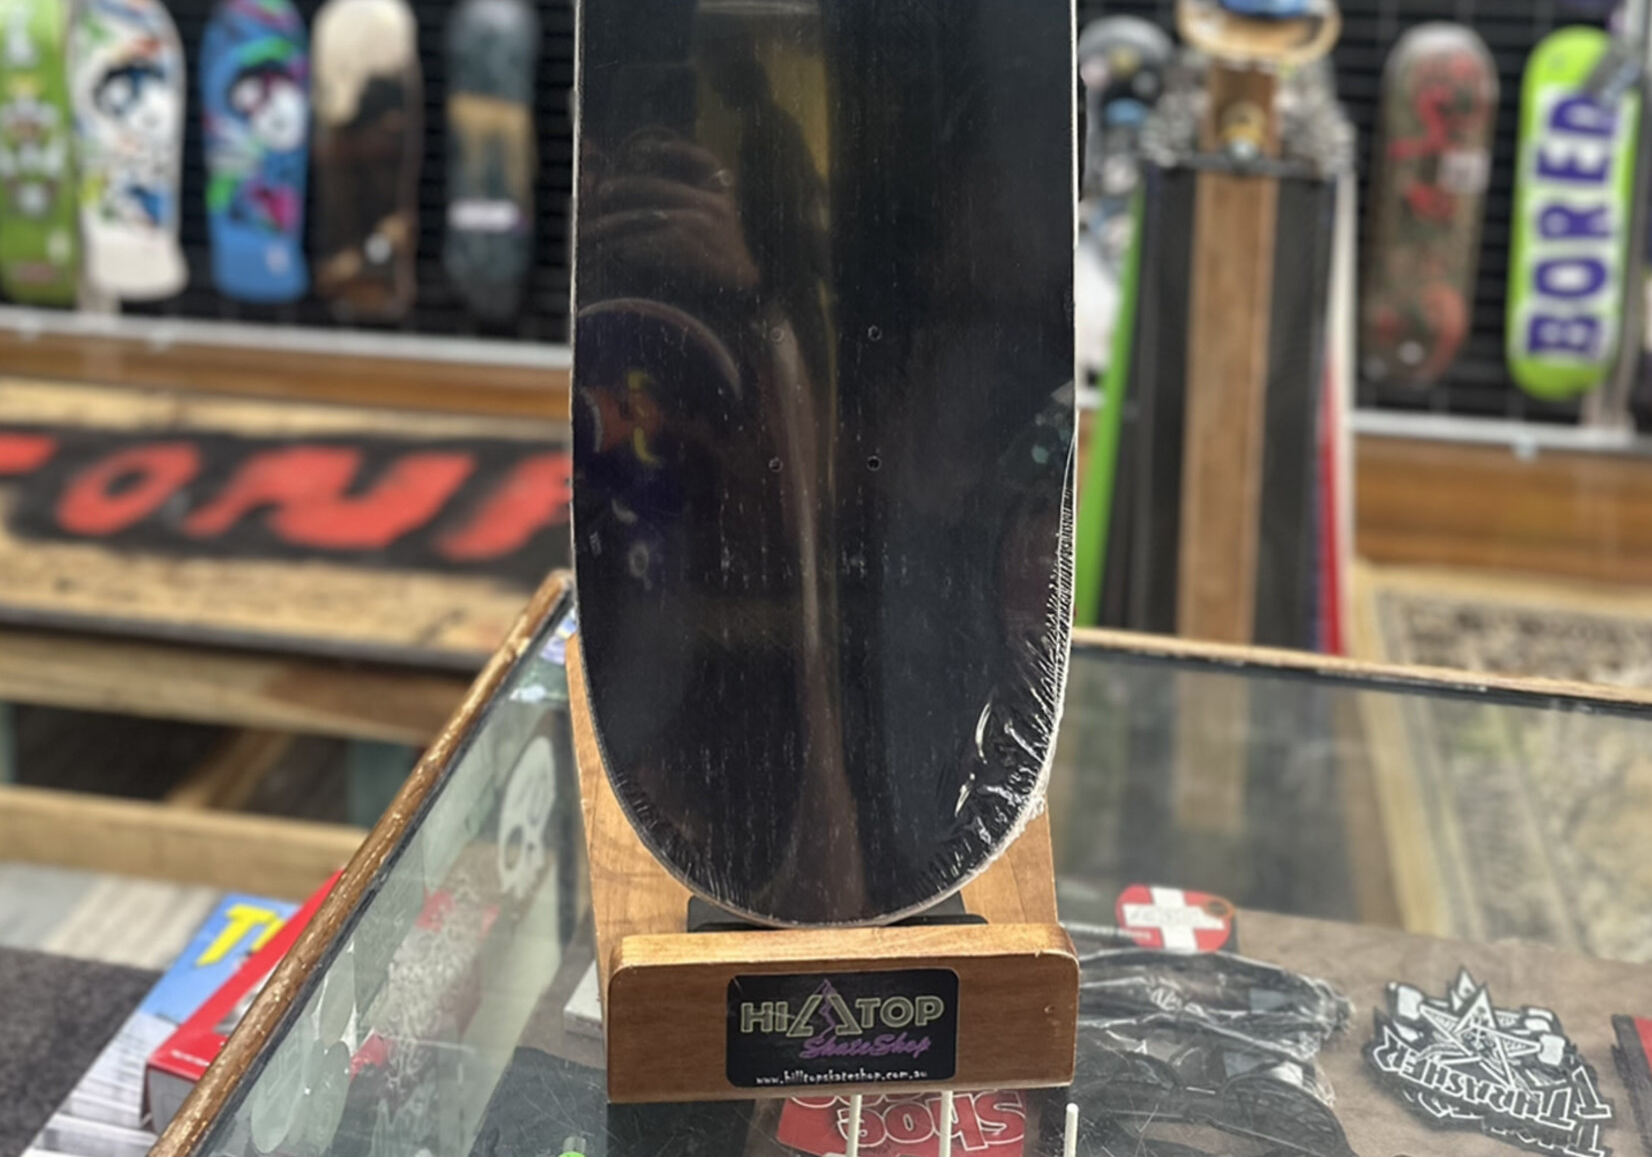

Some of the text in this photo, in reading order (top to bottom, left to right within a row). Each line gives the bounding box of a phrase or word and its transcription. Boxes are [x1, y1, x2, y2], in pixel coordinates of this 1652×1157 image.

[1527, 94, 1617, 358] BORED
[755, 1068, 928, 1085] www.hilltopskateshop.com.au
[1373, 1026, 1577, 1131] THRASHER
